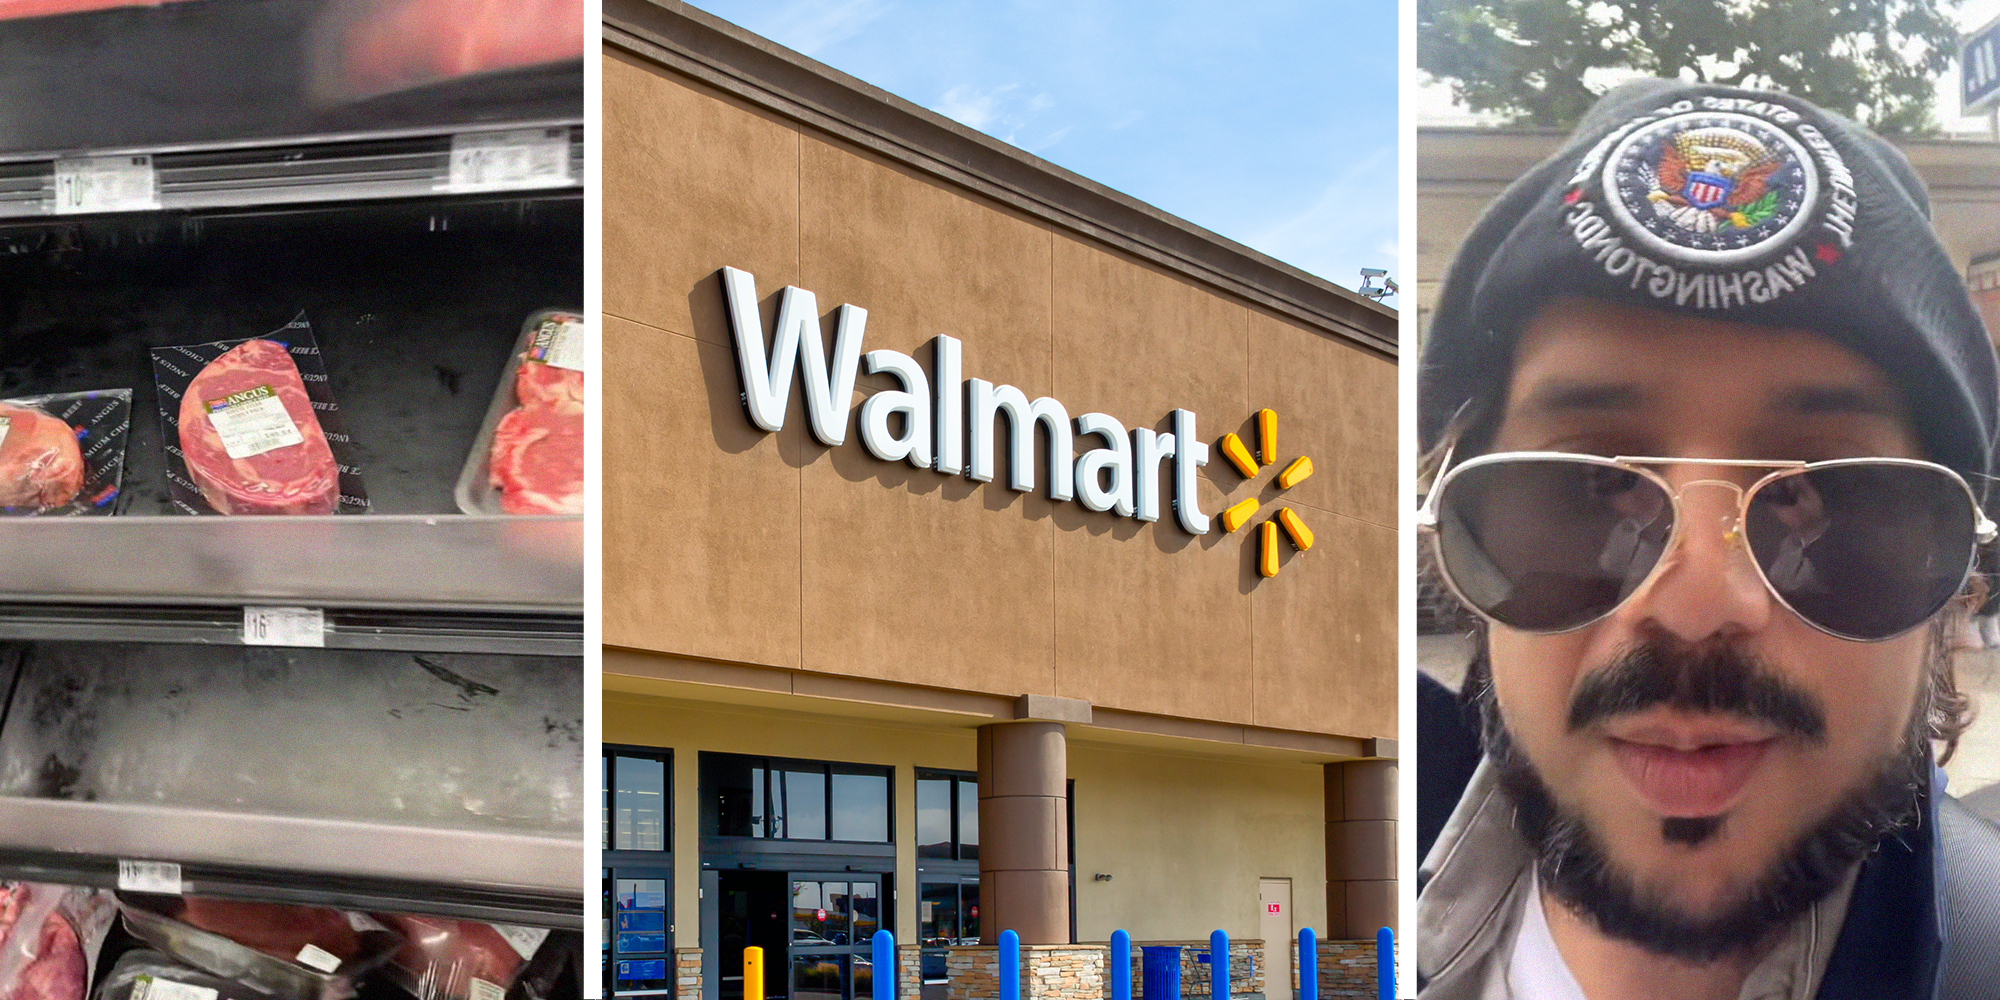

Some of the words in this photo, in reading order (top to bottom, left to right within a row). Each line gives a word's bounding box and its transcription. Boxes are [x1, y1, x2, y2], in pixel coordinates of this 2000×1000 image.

[160, 359, 190, 377] ANGUS
[158, 383, 181, 399] BEEF
[227, 385, 269, 405] ANGUS
[720, 265, 1209, 535] Walmart
[91, 399, 120, 425] ANGUS
